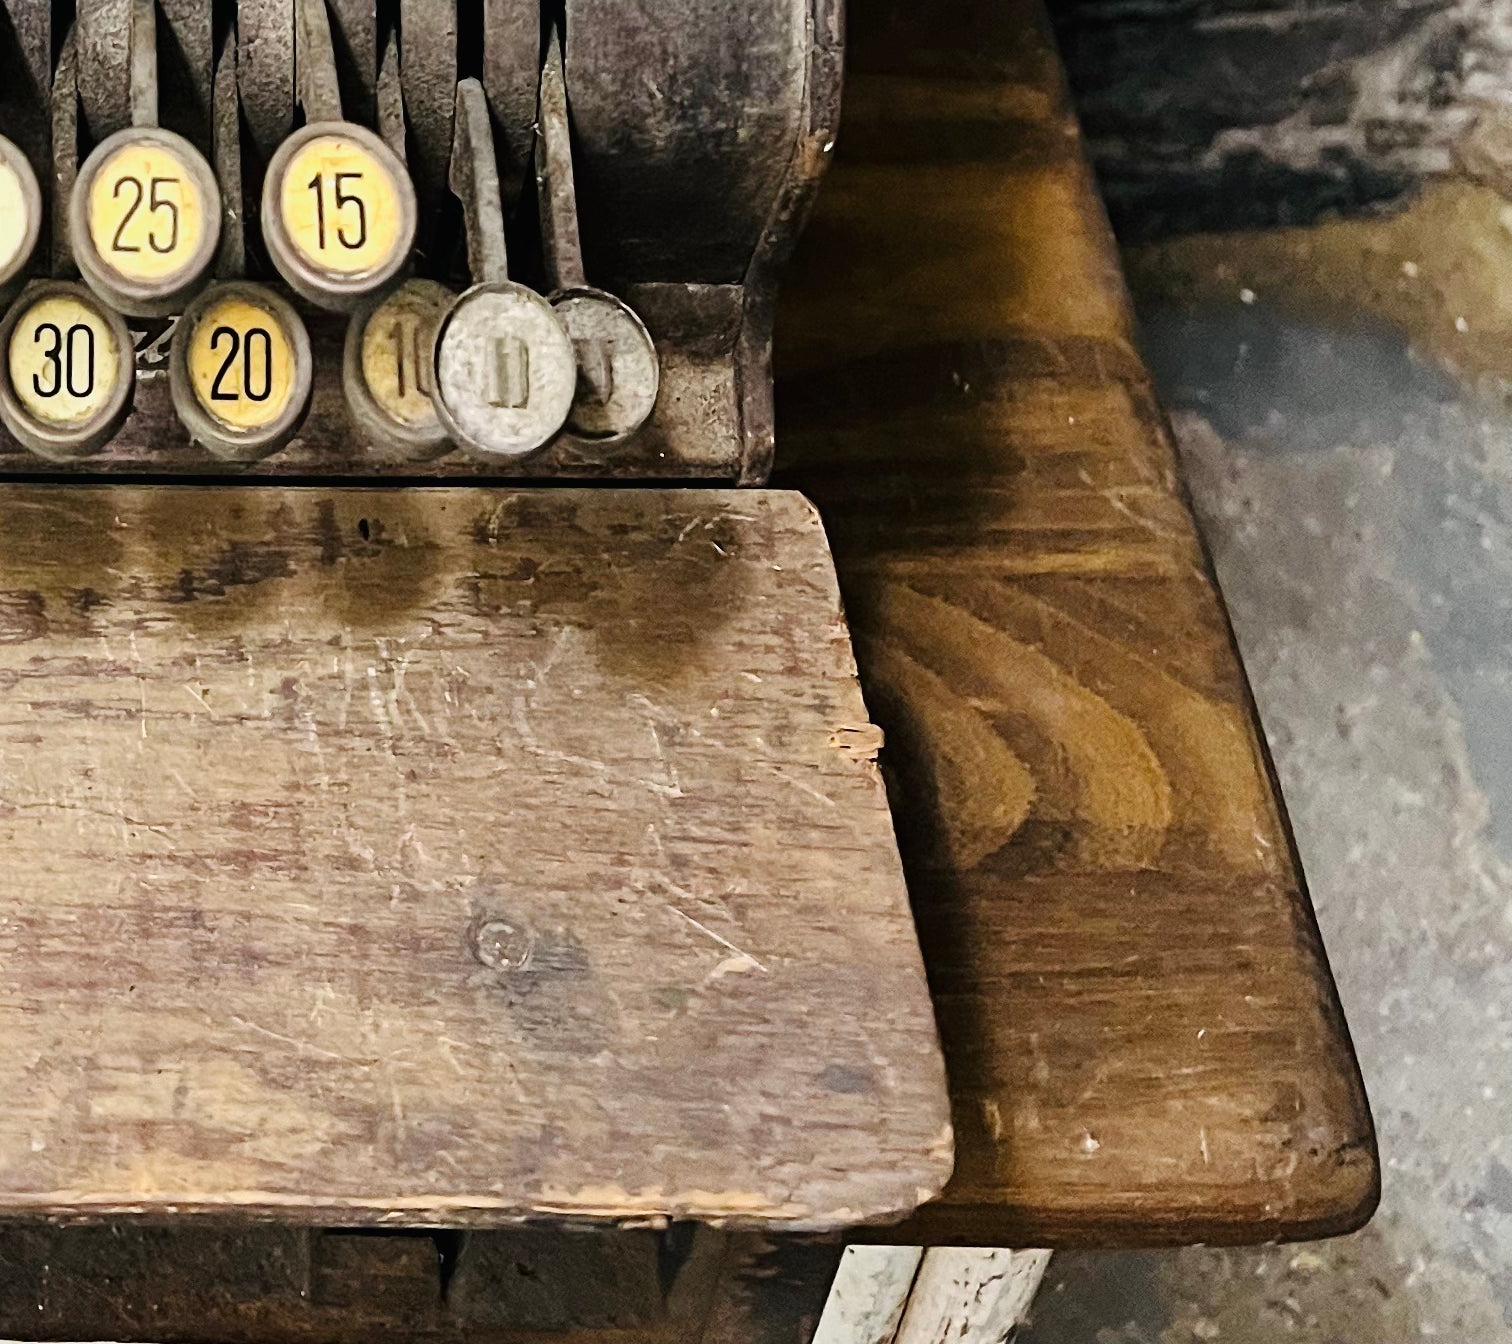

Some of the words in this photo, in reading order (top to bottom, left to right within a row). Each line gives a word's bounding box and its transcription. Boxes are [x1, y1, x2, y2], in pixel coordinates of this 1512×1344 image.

[111, 176, 180, 254] 25
[309, 172, 368, 250] 15
[32, 323, 95, 398] 30
[210, 327, 272, 402] 20
